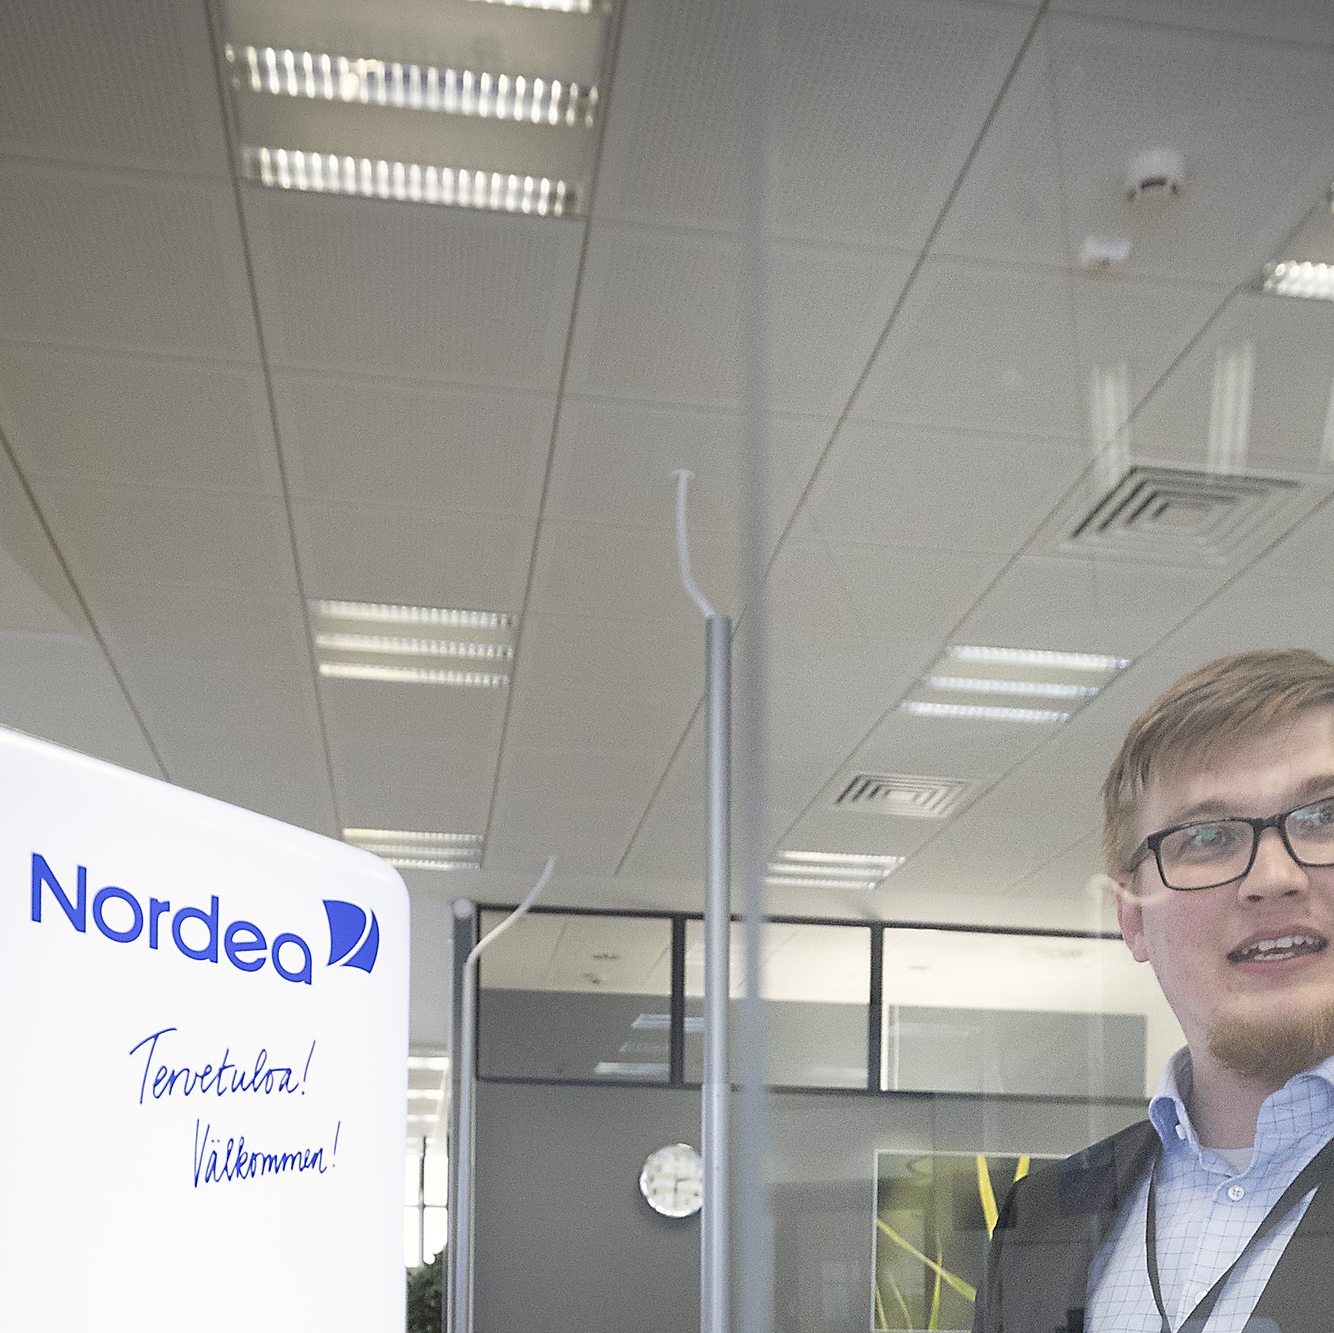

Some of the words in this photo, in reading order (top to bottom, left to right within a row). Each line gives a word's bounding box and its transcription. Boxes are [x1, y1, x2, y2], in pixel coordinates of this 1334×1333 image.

[30, 850, 313, 985] Nordea
[129, 1027, 317, 1105] Tervetuloa!
[194, 1118, 342, 1188] Välkommen!
